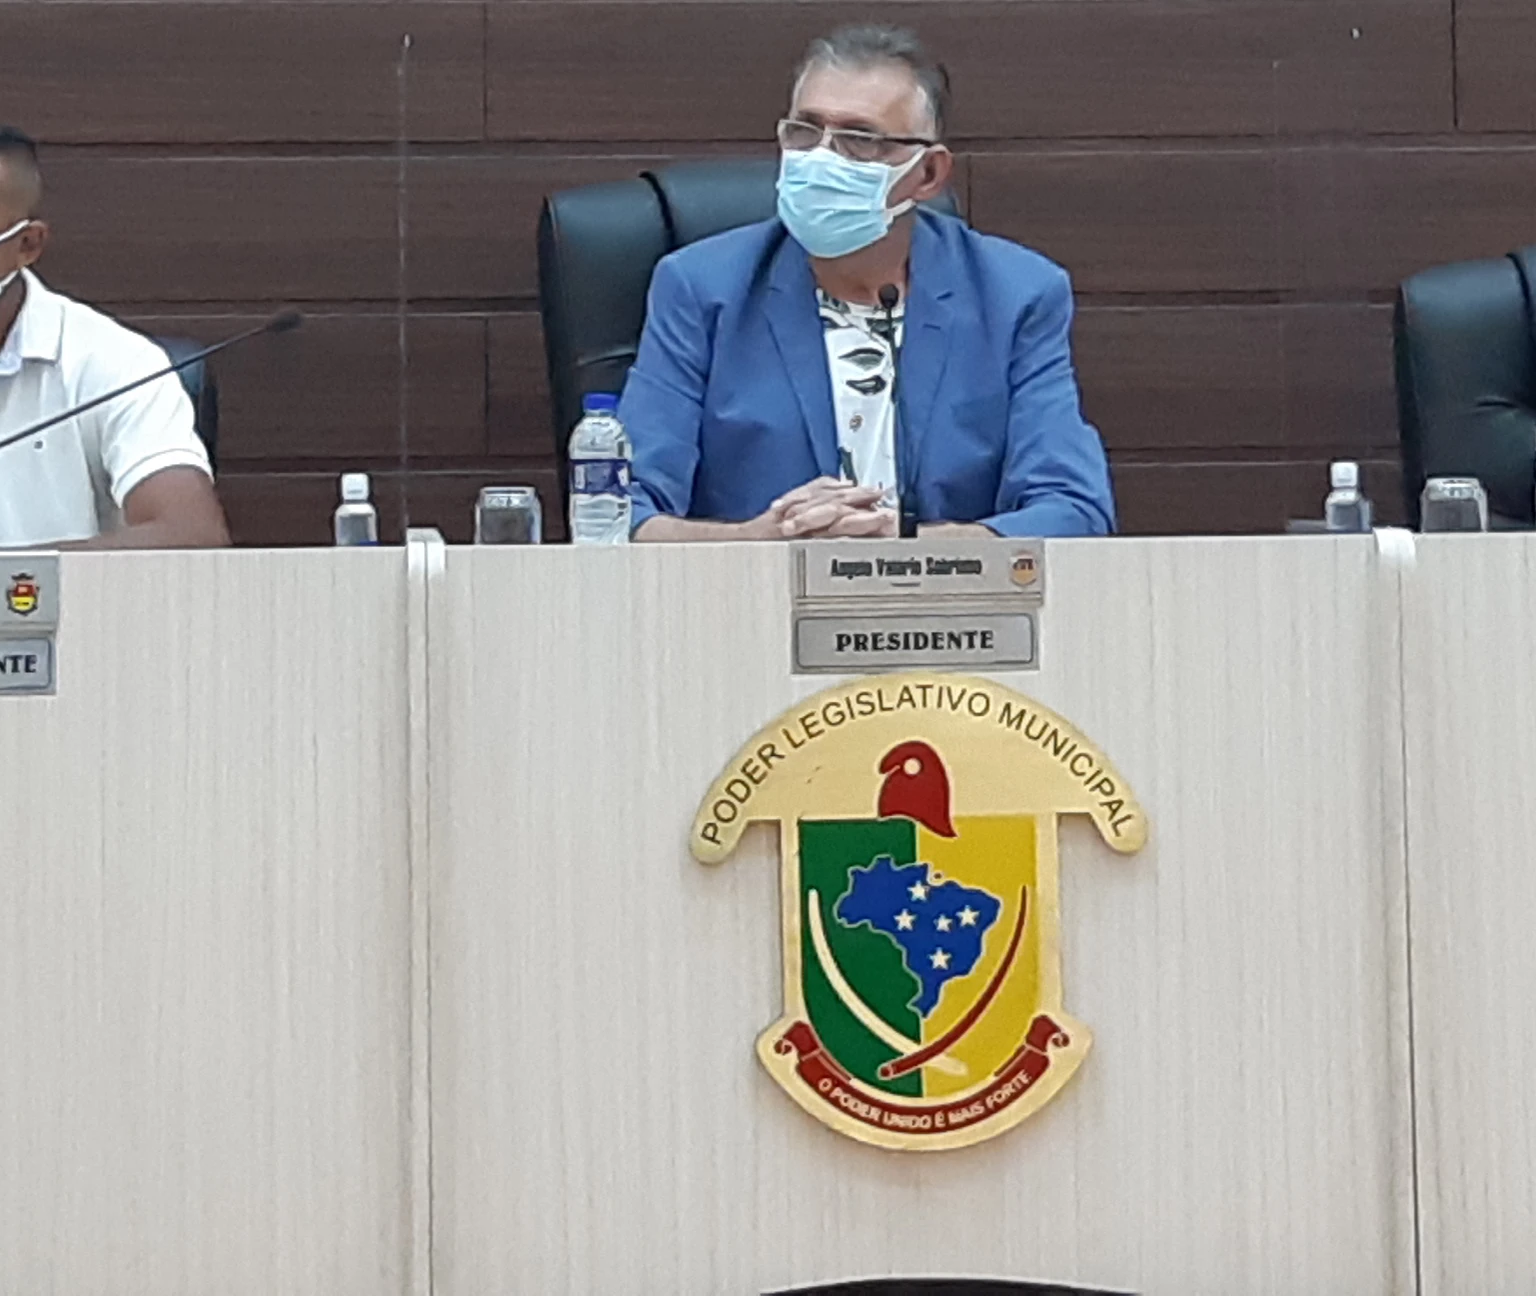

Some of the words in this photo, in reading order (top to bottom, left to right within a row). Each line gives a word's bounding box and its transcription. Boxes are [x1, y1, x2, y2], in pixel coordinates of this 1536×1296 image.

[835, 630, 994, 653] PRESIDENTE
[700, 742, 786, 846] PODER
[782, 684, 991, 750] LEGISLATIVO
[998, 701, 1134, 838] MUNICIPAL
[818, 1078, 833, 1092] O
[830, 1086, 881, 1123] PODER
[883, 1112, 932, 1130] UNIDO
[948, 1100, 985, 1125] MAIS
[985, 1068, 1033, 1110] FORTE
